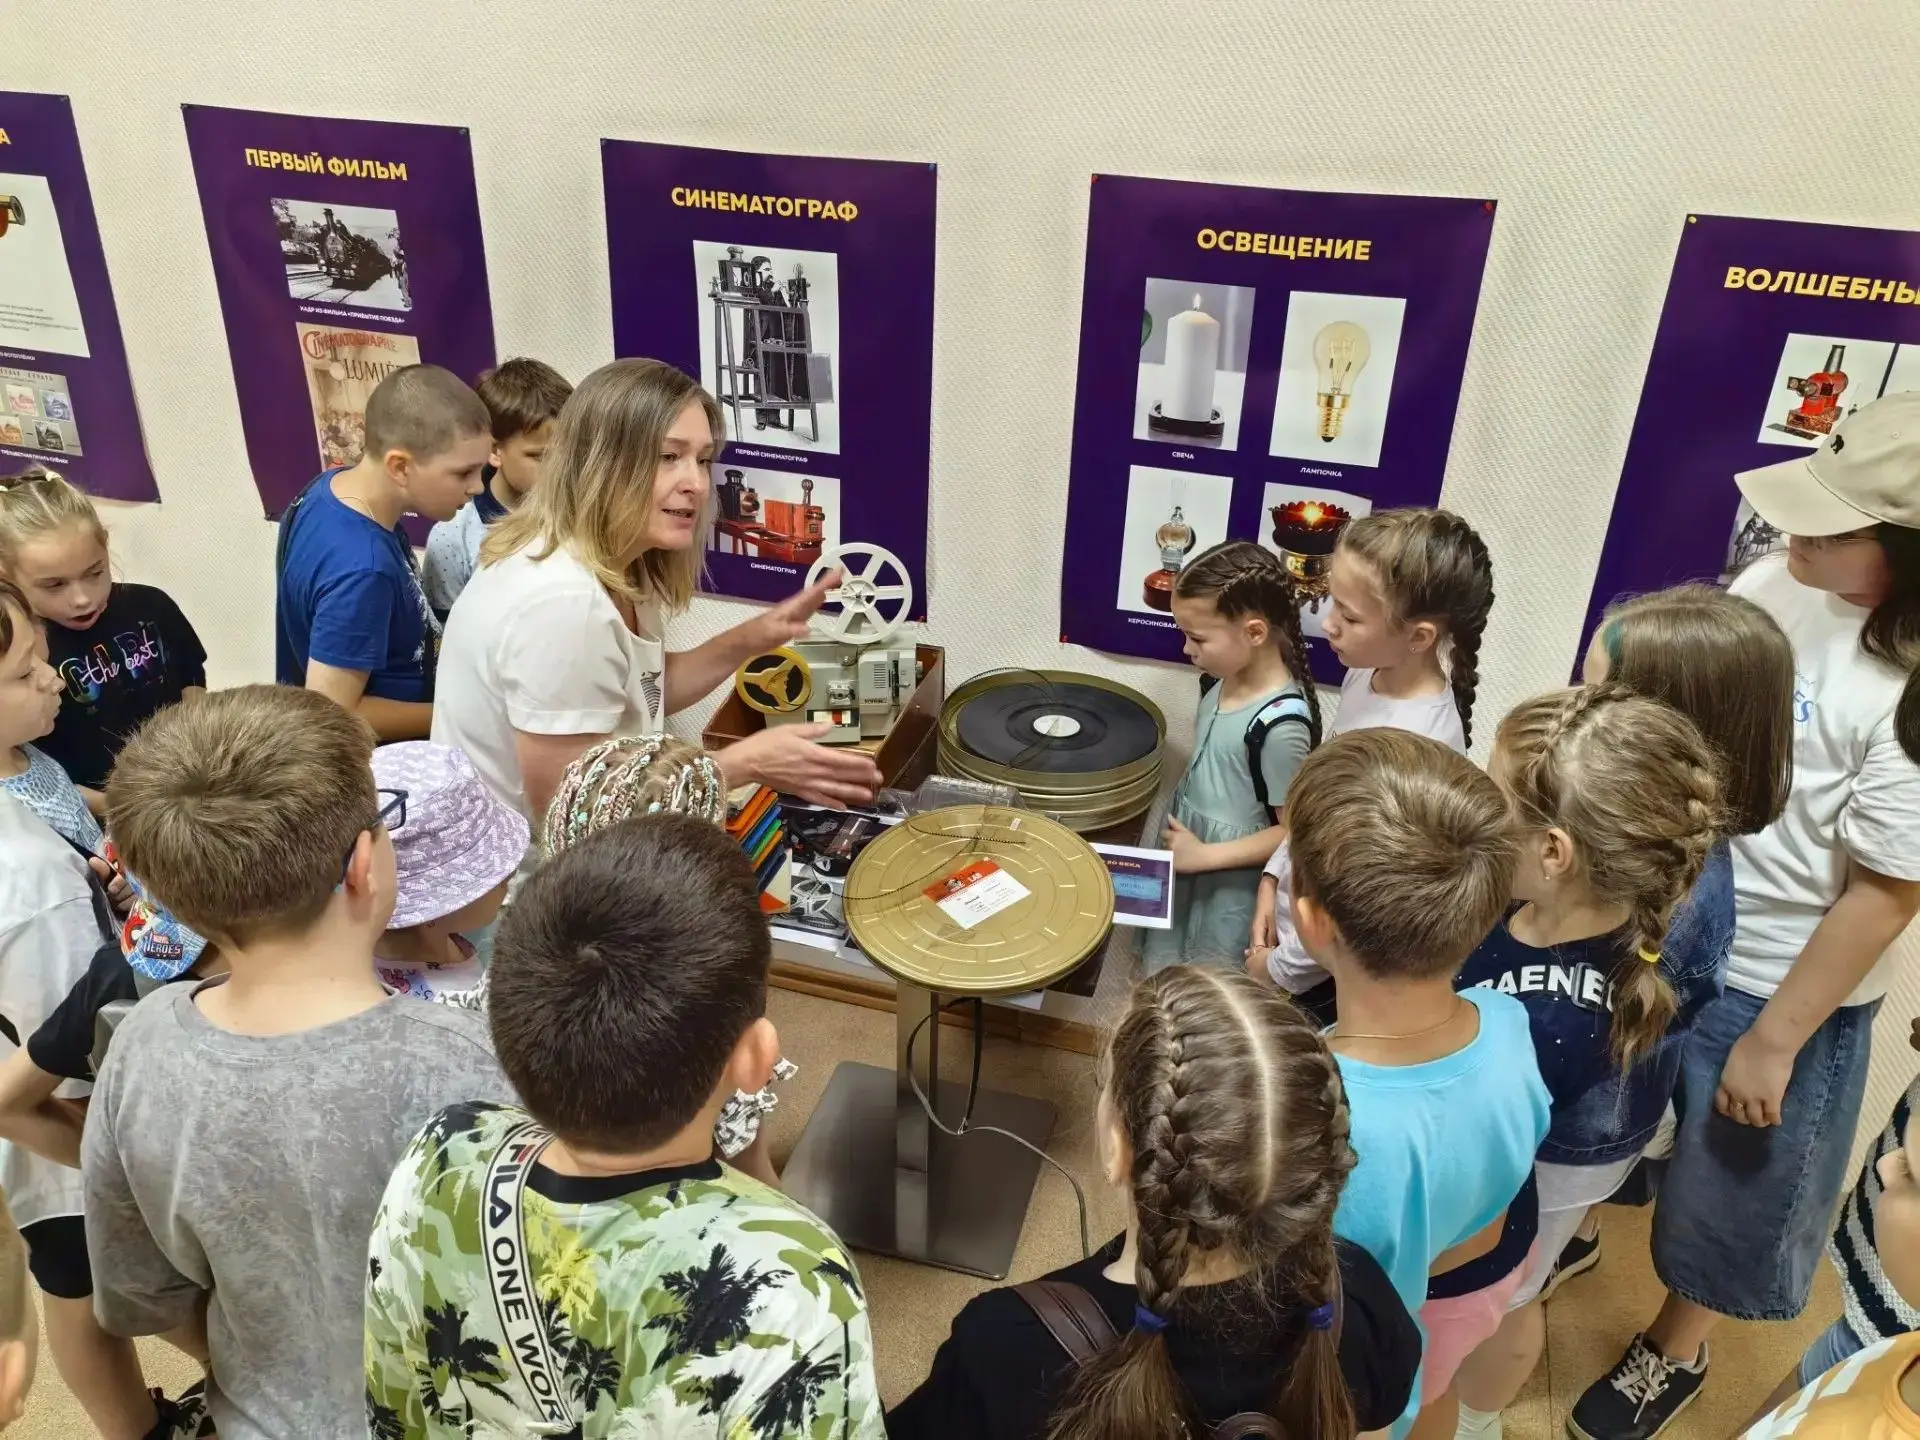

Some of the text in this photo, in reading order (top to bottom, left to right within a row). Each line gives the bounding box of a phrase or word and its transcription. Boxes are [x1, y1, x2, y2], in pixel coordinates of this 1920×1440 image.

[245, 148, 408, 181] ПЕРВЫЙ ФИЛЬМ
[671, 187, 858, 222] СИНЕМАТОГРАФ
[1197, 228, 1372, 260] ОСВЕЩЕНИЕ
[735, 448, 808, 463] ПЕРВЫЙ СИНЕМАТОГРАФ
[1172, 451, 1195, 460] СВЕЧА
[1300, 467, 1343, 477] ЛАМПОЧКА
[750, 562, 797, 574] СИНЕМАТОГРАФ
[1127, 617, 1177, 628] КЕРОСИНОВАЯ
[81, 629, 158, 684] the best
[143, 931, 181, 954] HEROES
[489, 1144, 536, 1229] FILA
[493, 1237, 529, 1323] ONE
